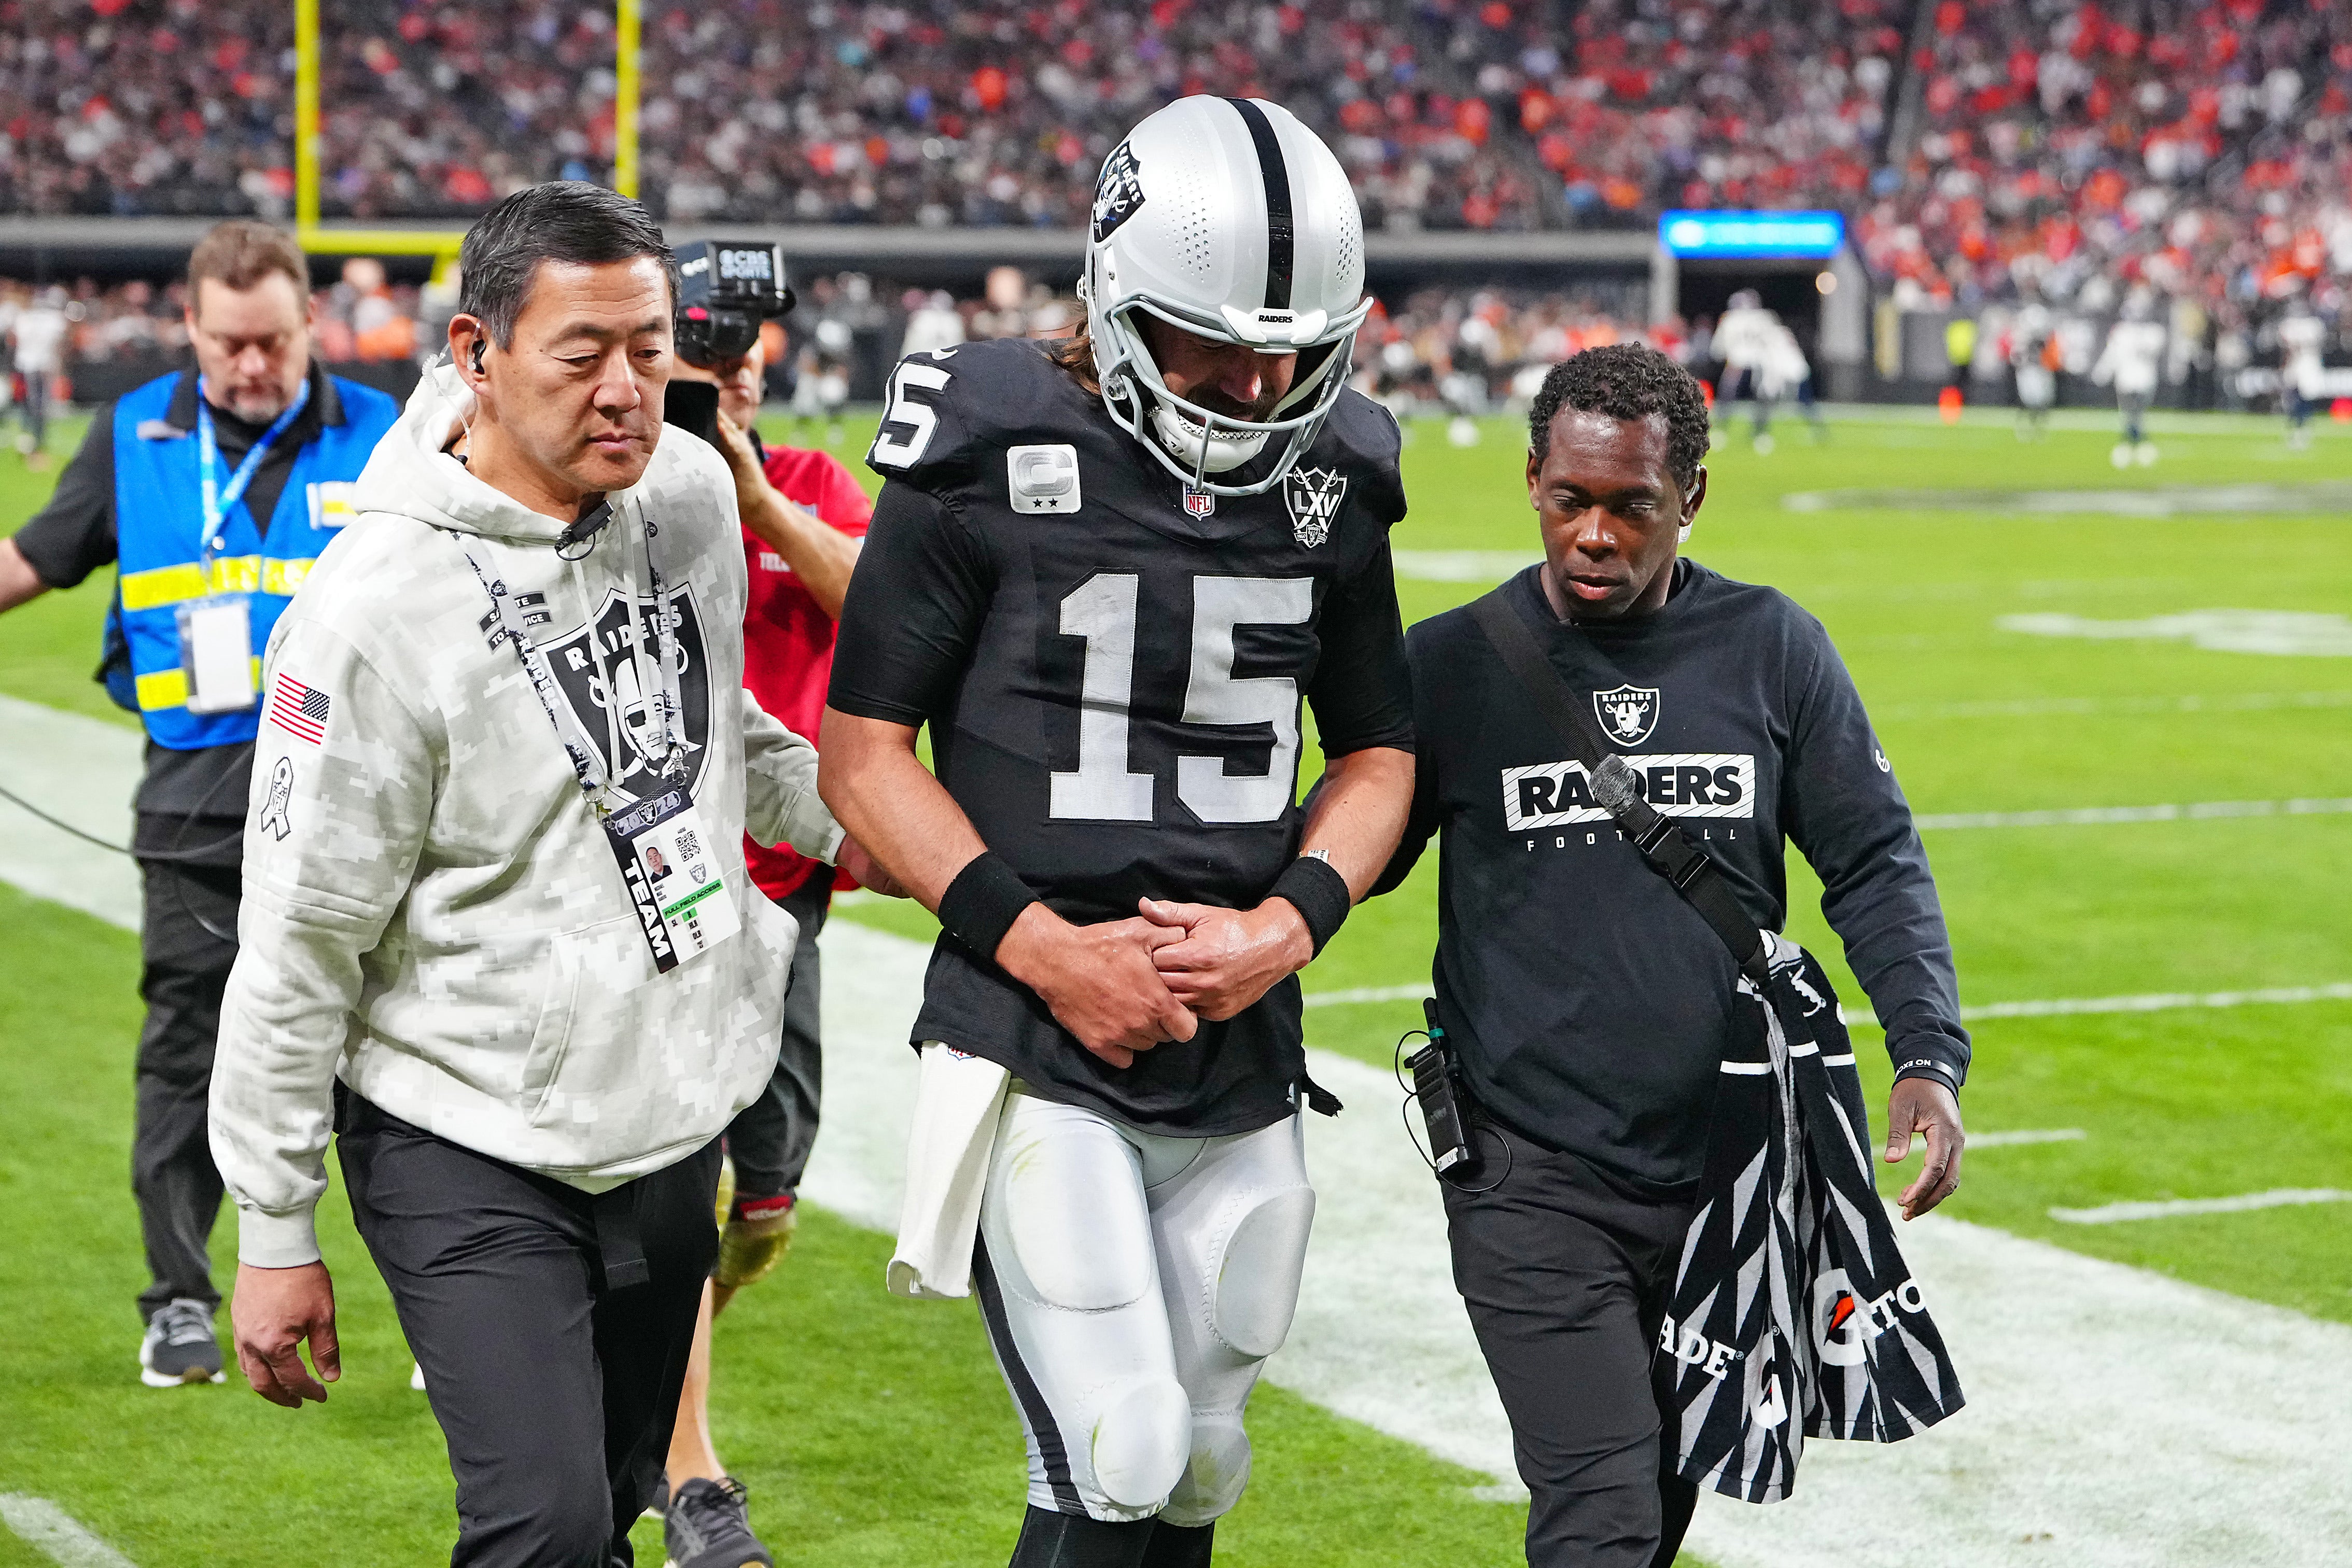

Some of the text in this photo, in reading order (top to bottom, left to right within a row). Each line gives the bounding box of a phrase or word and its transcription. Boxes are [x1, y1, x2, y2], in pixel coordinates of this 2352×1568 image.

[1119, 145, 1141, 202] RAIDERS
[1258, 315, 1293, 323] RAIDERS
[1015, 451, 1073, 497] C
[1188, 495, 1210, 512] NFL
[1294, 491, 1340, 517] LXV
[492, 632, 504, 645] TO
[519, 637, 561, 710] RAIDERS
[1048, 573, 1314, 823] 15
[1602, 692, 1652, 703] RAIDERS
[1517, 765, 1743, 818] RAERS
[1527, 829, 1736, 852] FOOTLL
[625, 857, 671, 958] TEAM
[664, 906, 680, 916] FULL
[680, 896, 696, 908] FIELD
[697, 883, 721, 899] ACCESS
[1414, 1048, 1432, 1062] MOTOROLA
